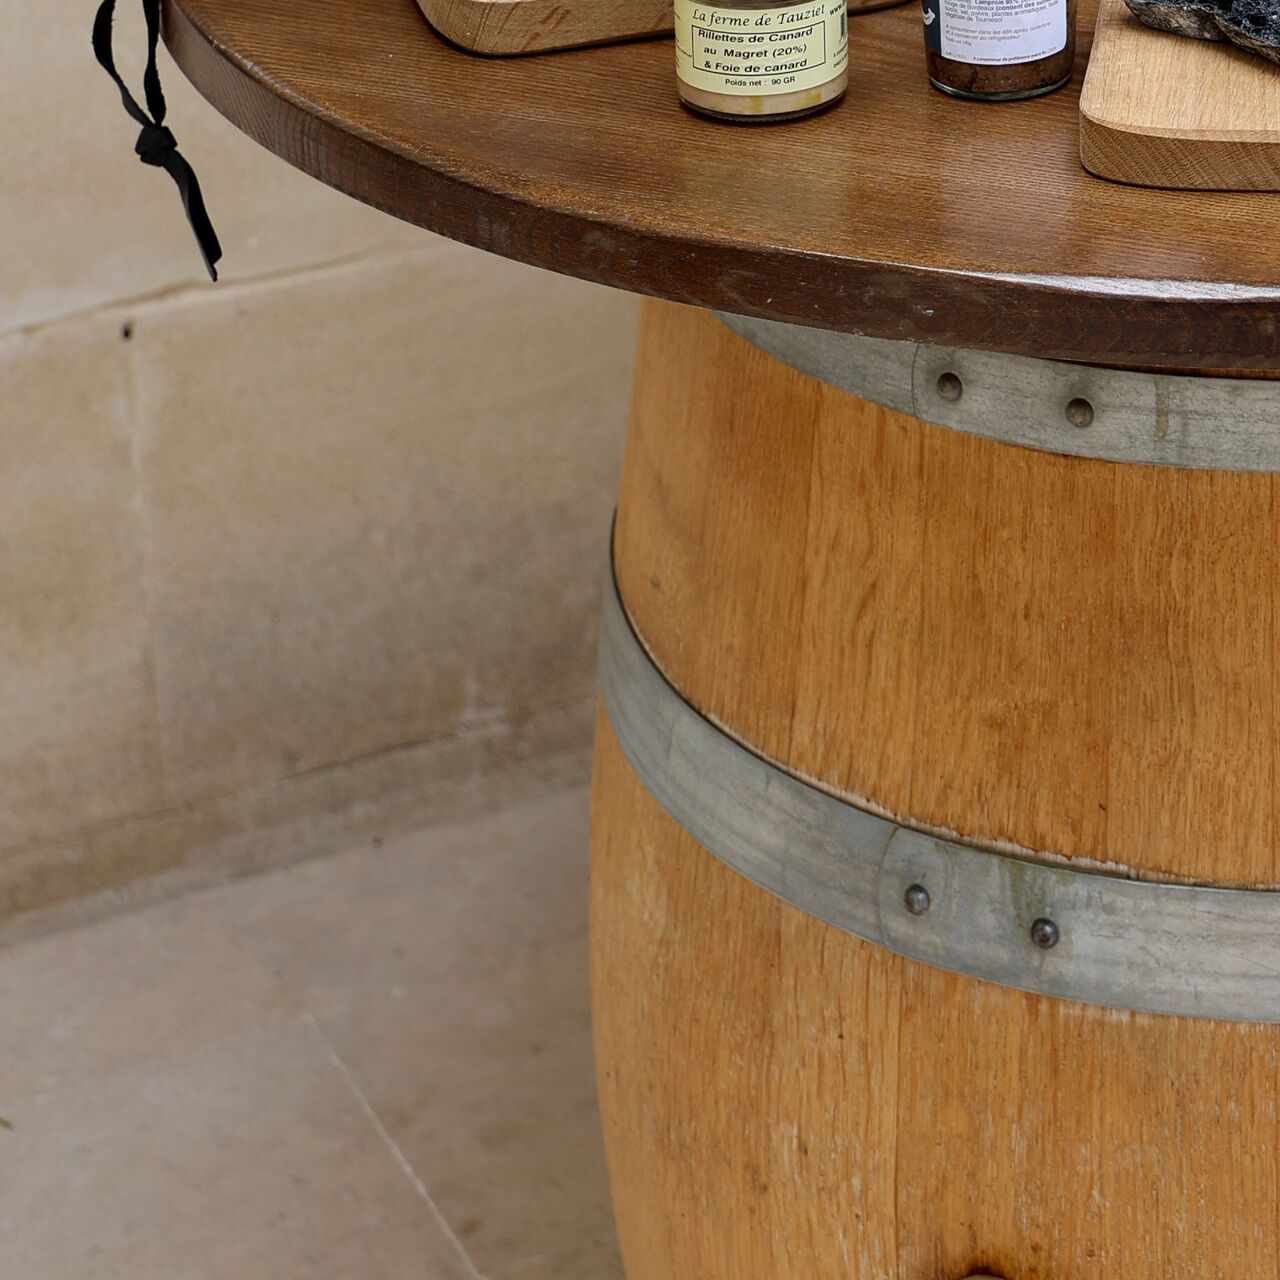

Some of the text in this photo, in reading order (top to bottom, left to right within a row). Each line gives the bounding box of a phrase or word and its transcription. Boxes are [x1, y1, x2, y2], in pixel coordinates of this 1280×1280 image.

[692, 4, 825, 27] La ferme de Tauziet
[992, 10, 1013, 18] plantes
[698, 29, 744, 43] Rillettes
[769, 27, 813, 42] Canard
[703, 47, 717, 55] au
[724, 49, 768, 59] Magret
[772, 44, 807, 58] (20%)
[704, 59, 807, 73] & Foie de canard
[725, 78, 747, 86] Poids
